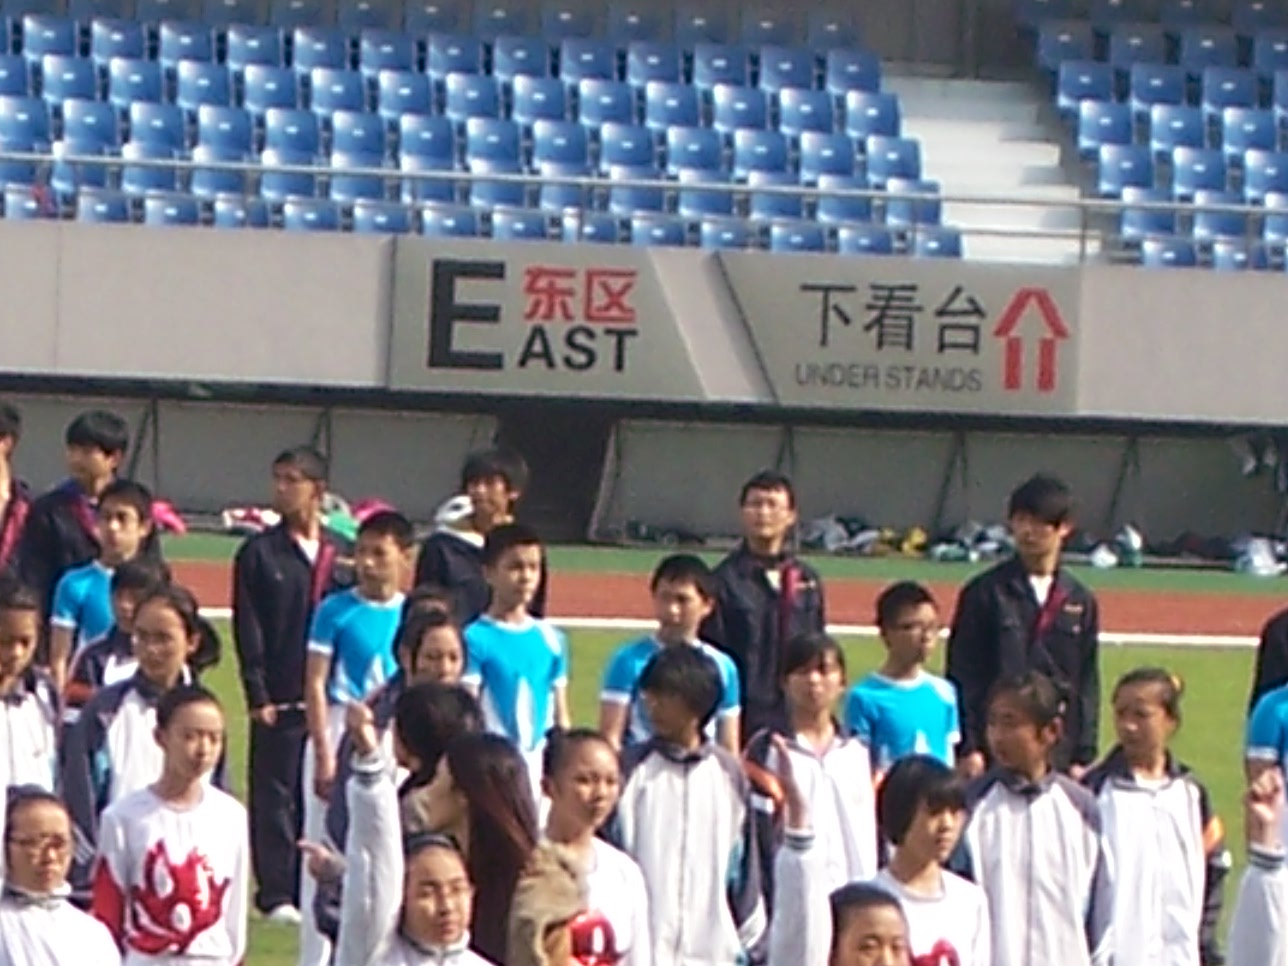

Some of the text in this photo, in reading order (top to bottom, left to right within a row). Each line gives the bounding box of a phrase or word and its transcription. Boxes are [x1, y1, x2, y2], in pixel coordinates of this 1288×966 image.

[523, 266, 638, 322] 东区
[799, 283, 987, 355] 下看台
